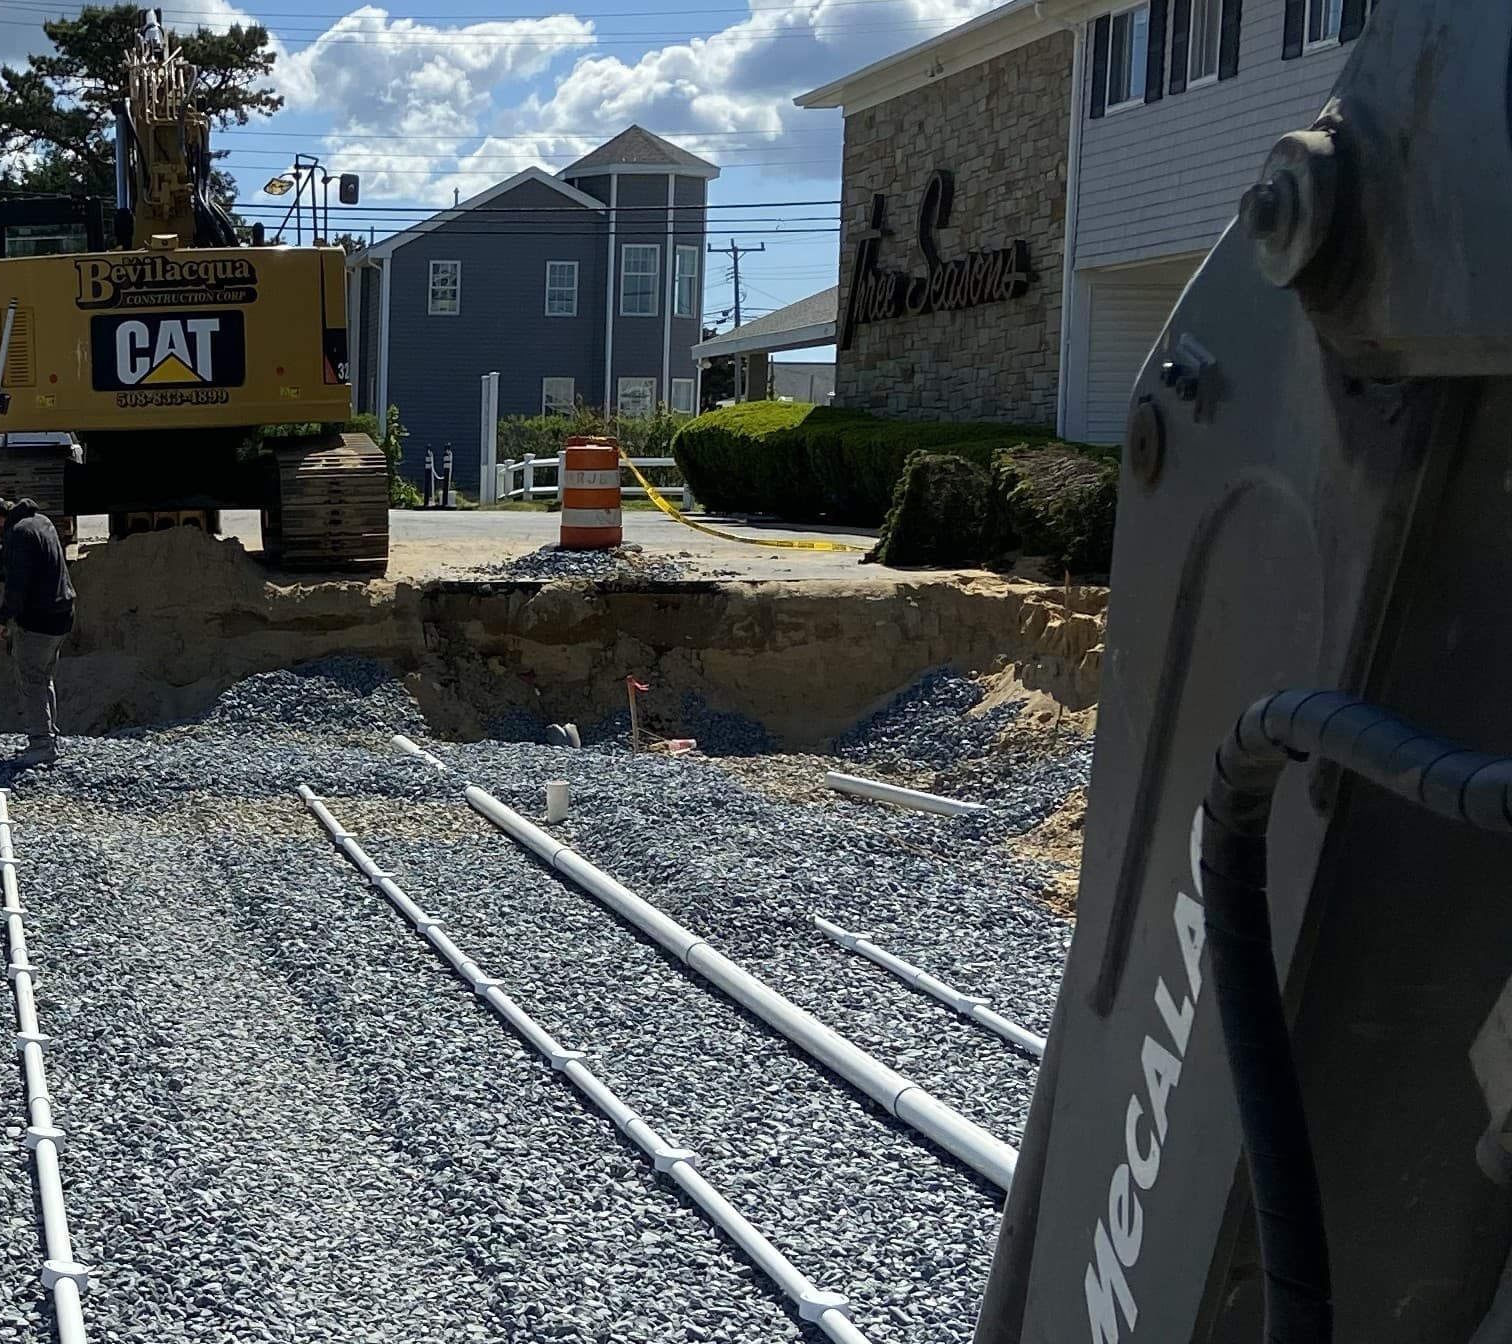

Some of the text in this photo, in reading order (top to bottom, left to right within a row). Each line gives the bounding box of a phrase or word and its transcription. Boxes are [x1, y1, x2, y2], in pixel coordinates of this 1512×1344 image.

[76, 257, 254, 305] Bevilacqua
[841, 169, 1032, 350] Three Seasons
[126, 290, 246, 306] CONSTRUCTION CORP
[115, 317, 220, 385] CAT
[116, 388, 229, 407] 508-833-4899
